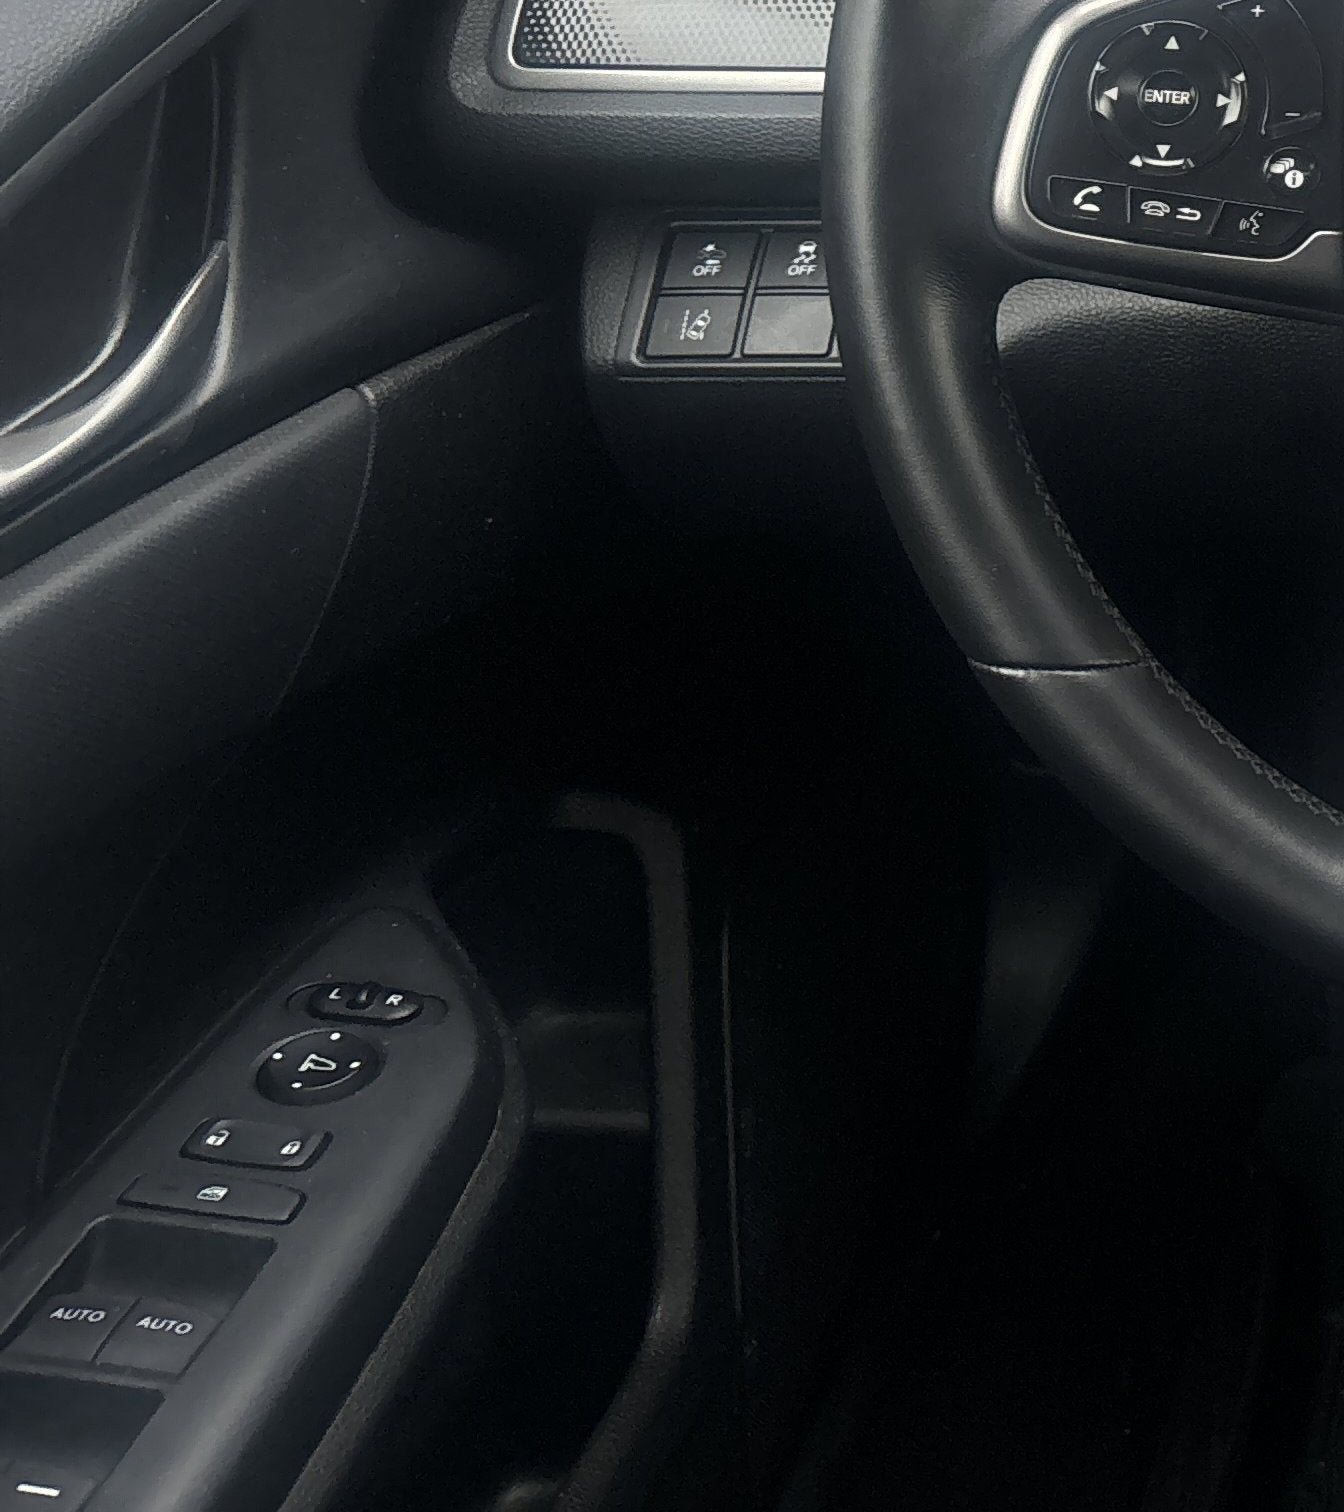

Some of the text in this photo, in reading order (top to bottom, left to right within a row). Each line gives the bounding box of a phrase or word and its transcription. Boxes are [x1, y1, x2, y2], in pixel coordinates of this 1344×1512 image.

[1144, 89, 1190, 106] ENTER
[692, 265, 722, 277] OFF
[787, 265, 817, 276] OFF
[328, 988, 342, 1000] L
[385, 994, 404, 1006] R
[50, 1306, 107, 1324] AUTO
[136, 1315, 193, 1335] AUTO
